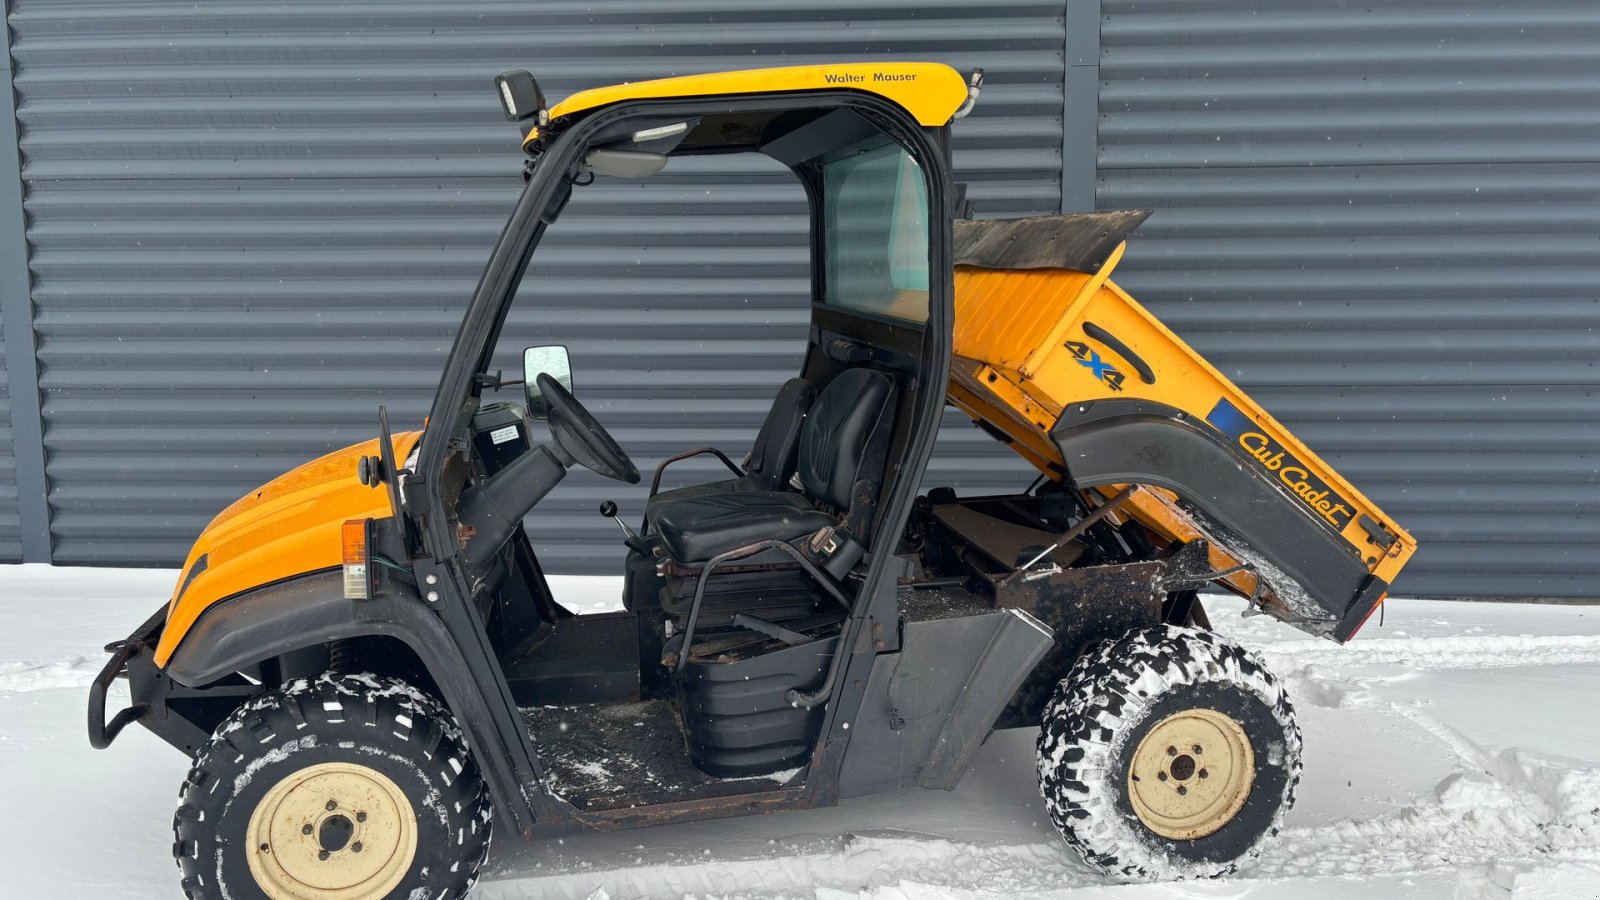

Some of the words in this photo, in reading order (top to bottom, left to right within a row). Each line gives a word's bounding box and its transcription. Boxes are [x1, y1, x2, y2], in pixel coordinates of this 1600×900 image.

[825, 73, 865, 83] Walter
[873, 72, 917, 82] Mauser
[1239, 432, 1285, 471] Cub
[1279, 466, 1351, 526] Cadet
